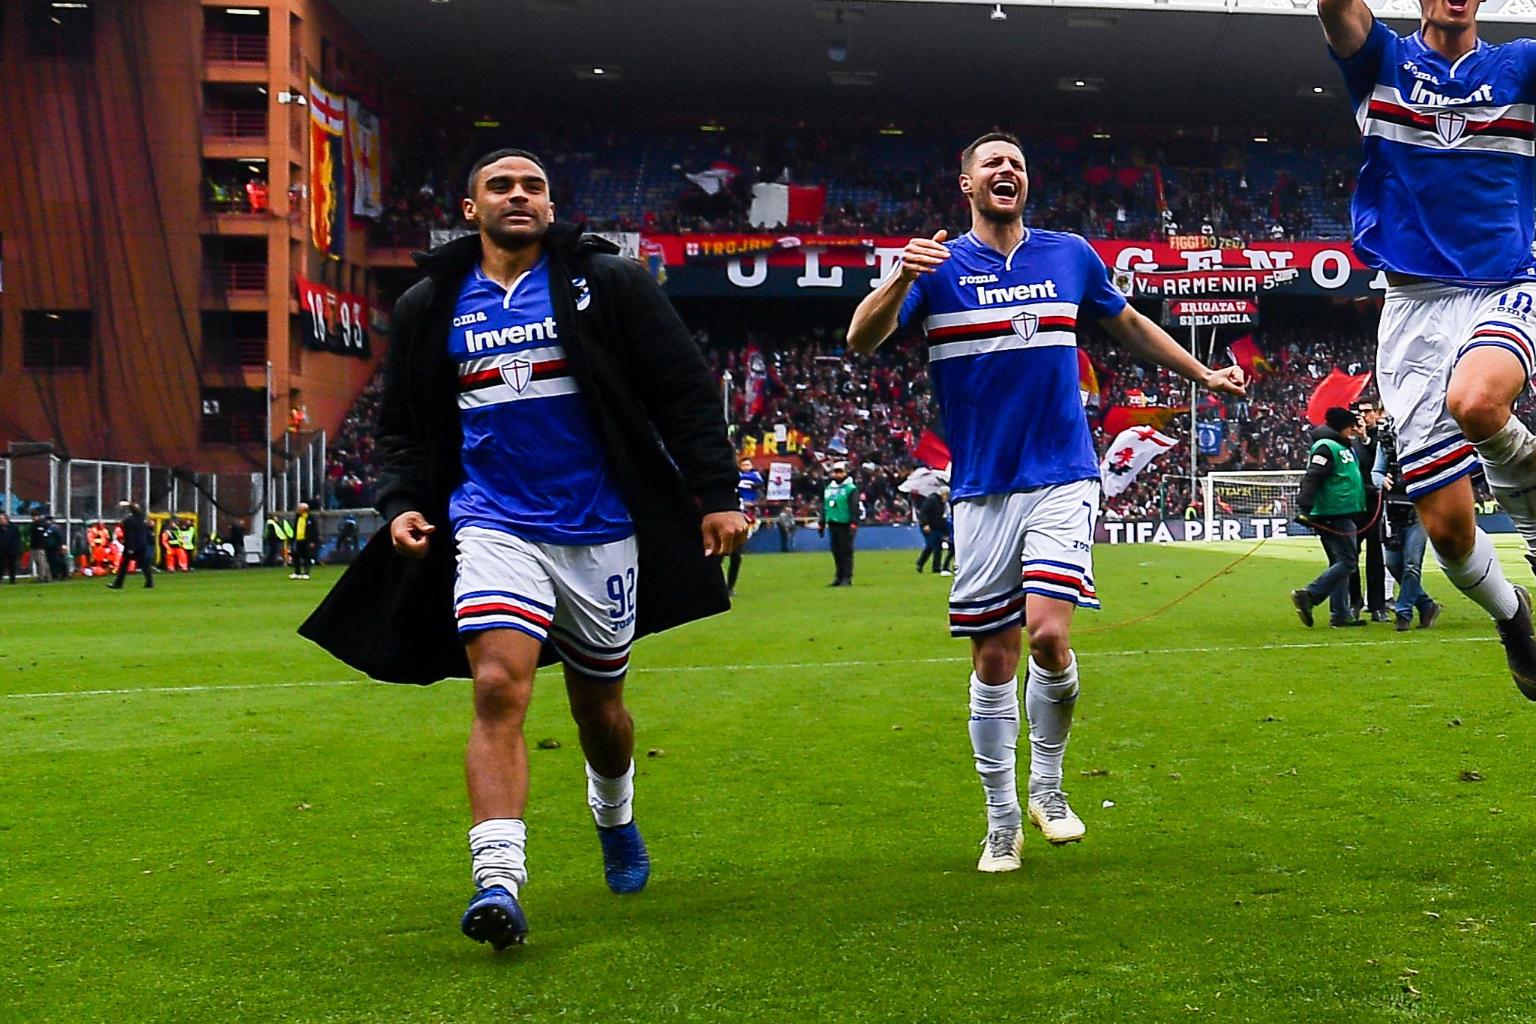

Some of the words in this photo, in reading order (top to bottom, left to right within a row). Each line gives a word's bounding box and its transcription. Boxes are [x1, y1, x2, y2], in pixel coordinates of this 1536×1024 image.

[958, 274, 999, 286] Joma
[1164, 277, 1256, 295] ARMENIA
[976, 280, 1058, 305] Invent
[1180, 302, 1236, 313] BRIGATA
[453, 311, 487, 327] oma
[465, 316, 558, 353] Invent
[1104, 522, 1175, 545] TIFA
[1185, 518, 1242, 543] PER
[1249, 518, 1289, 539] TE
[606, 567, 636, 619] 92
